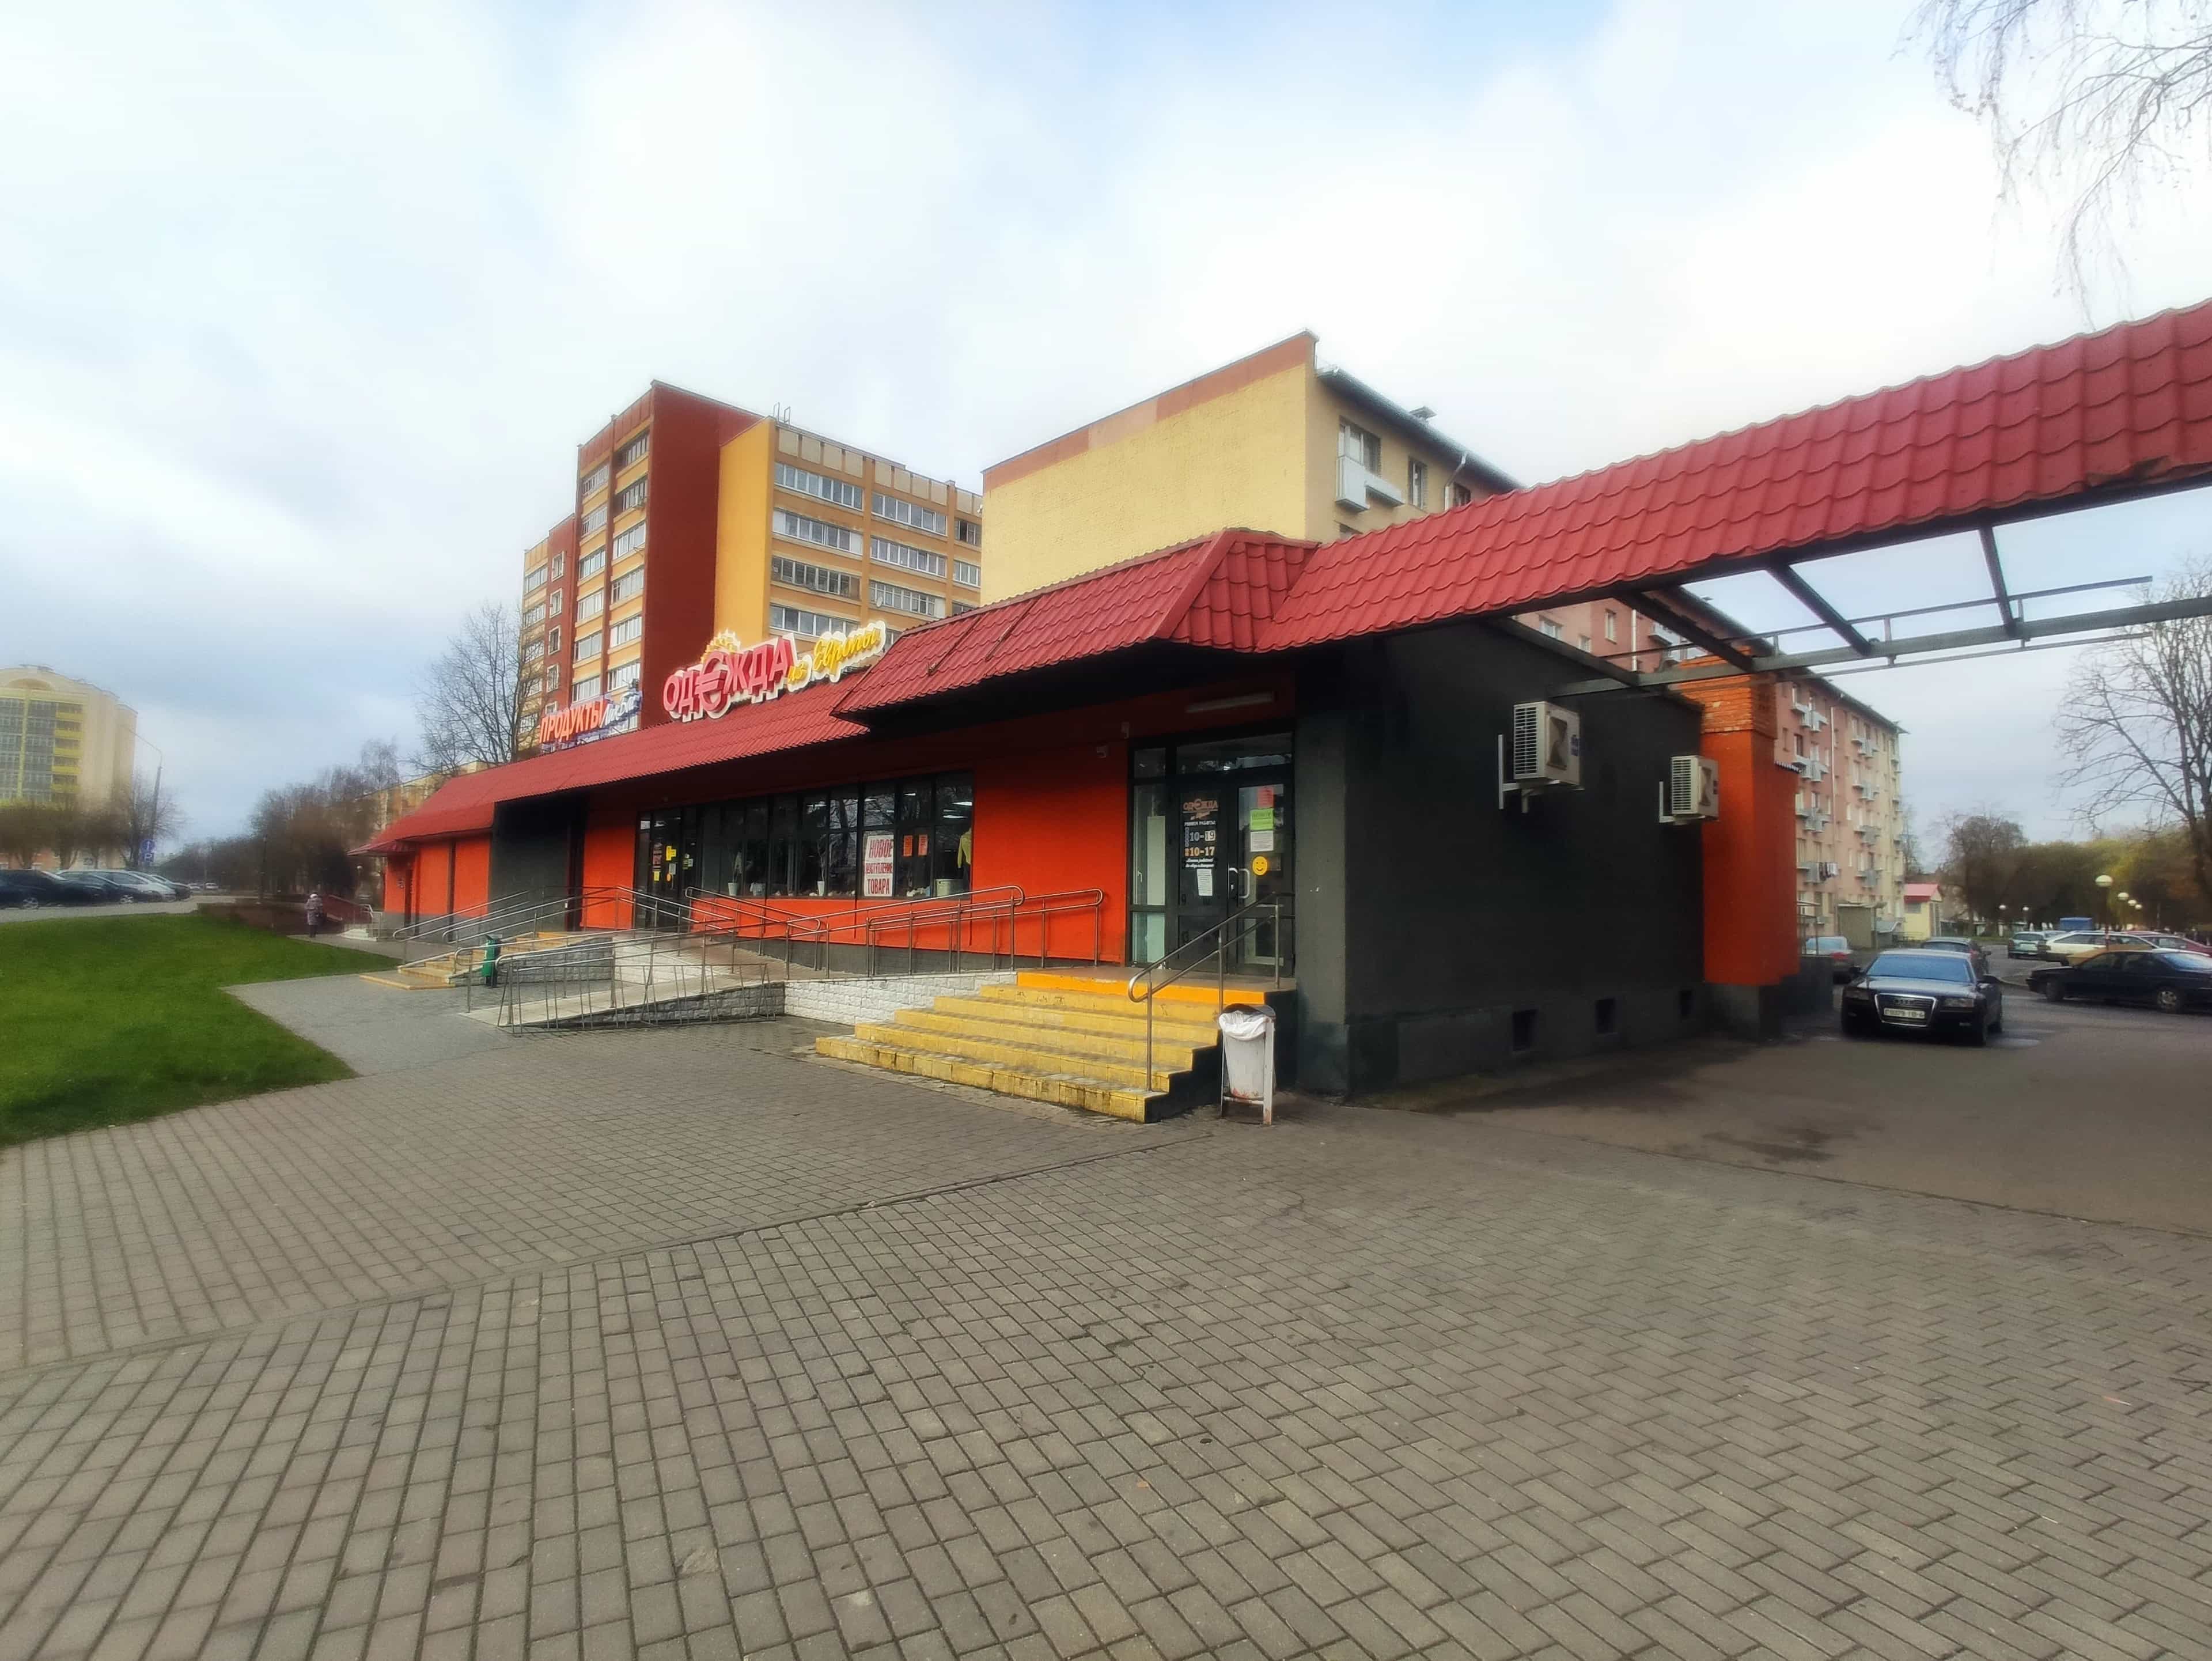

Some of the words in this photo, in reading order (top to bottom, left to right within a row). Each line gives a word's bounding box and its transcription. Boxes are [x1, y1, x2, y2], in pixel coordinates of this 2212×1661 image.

[813, 627, 881, 676] Европы
[539, 698, 607, 744] ПРОДУКТЫ
[869, 839, 893, 858] НОВОЕ
[1190, 846, 1215, 857] 10-17
[867, 878, 890, 895] ТОВАРА
